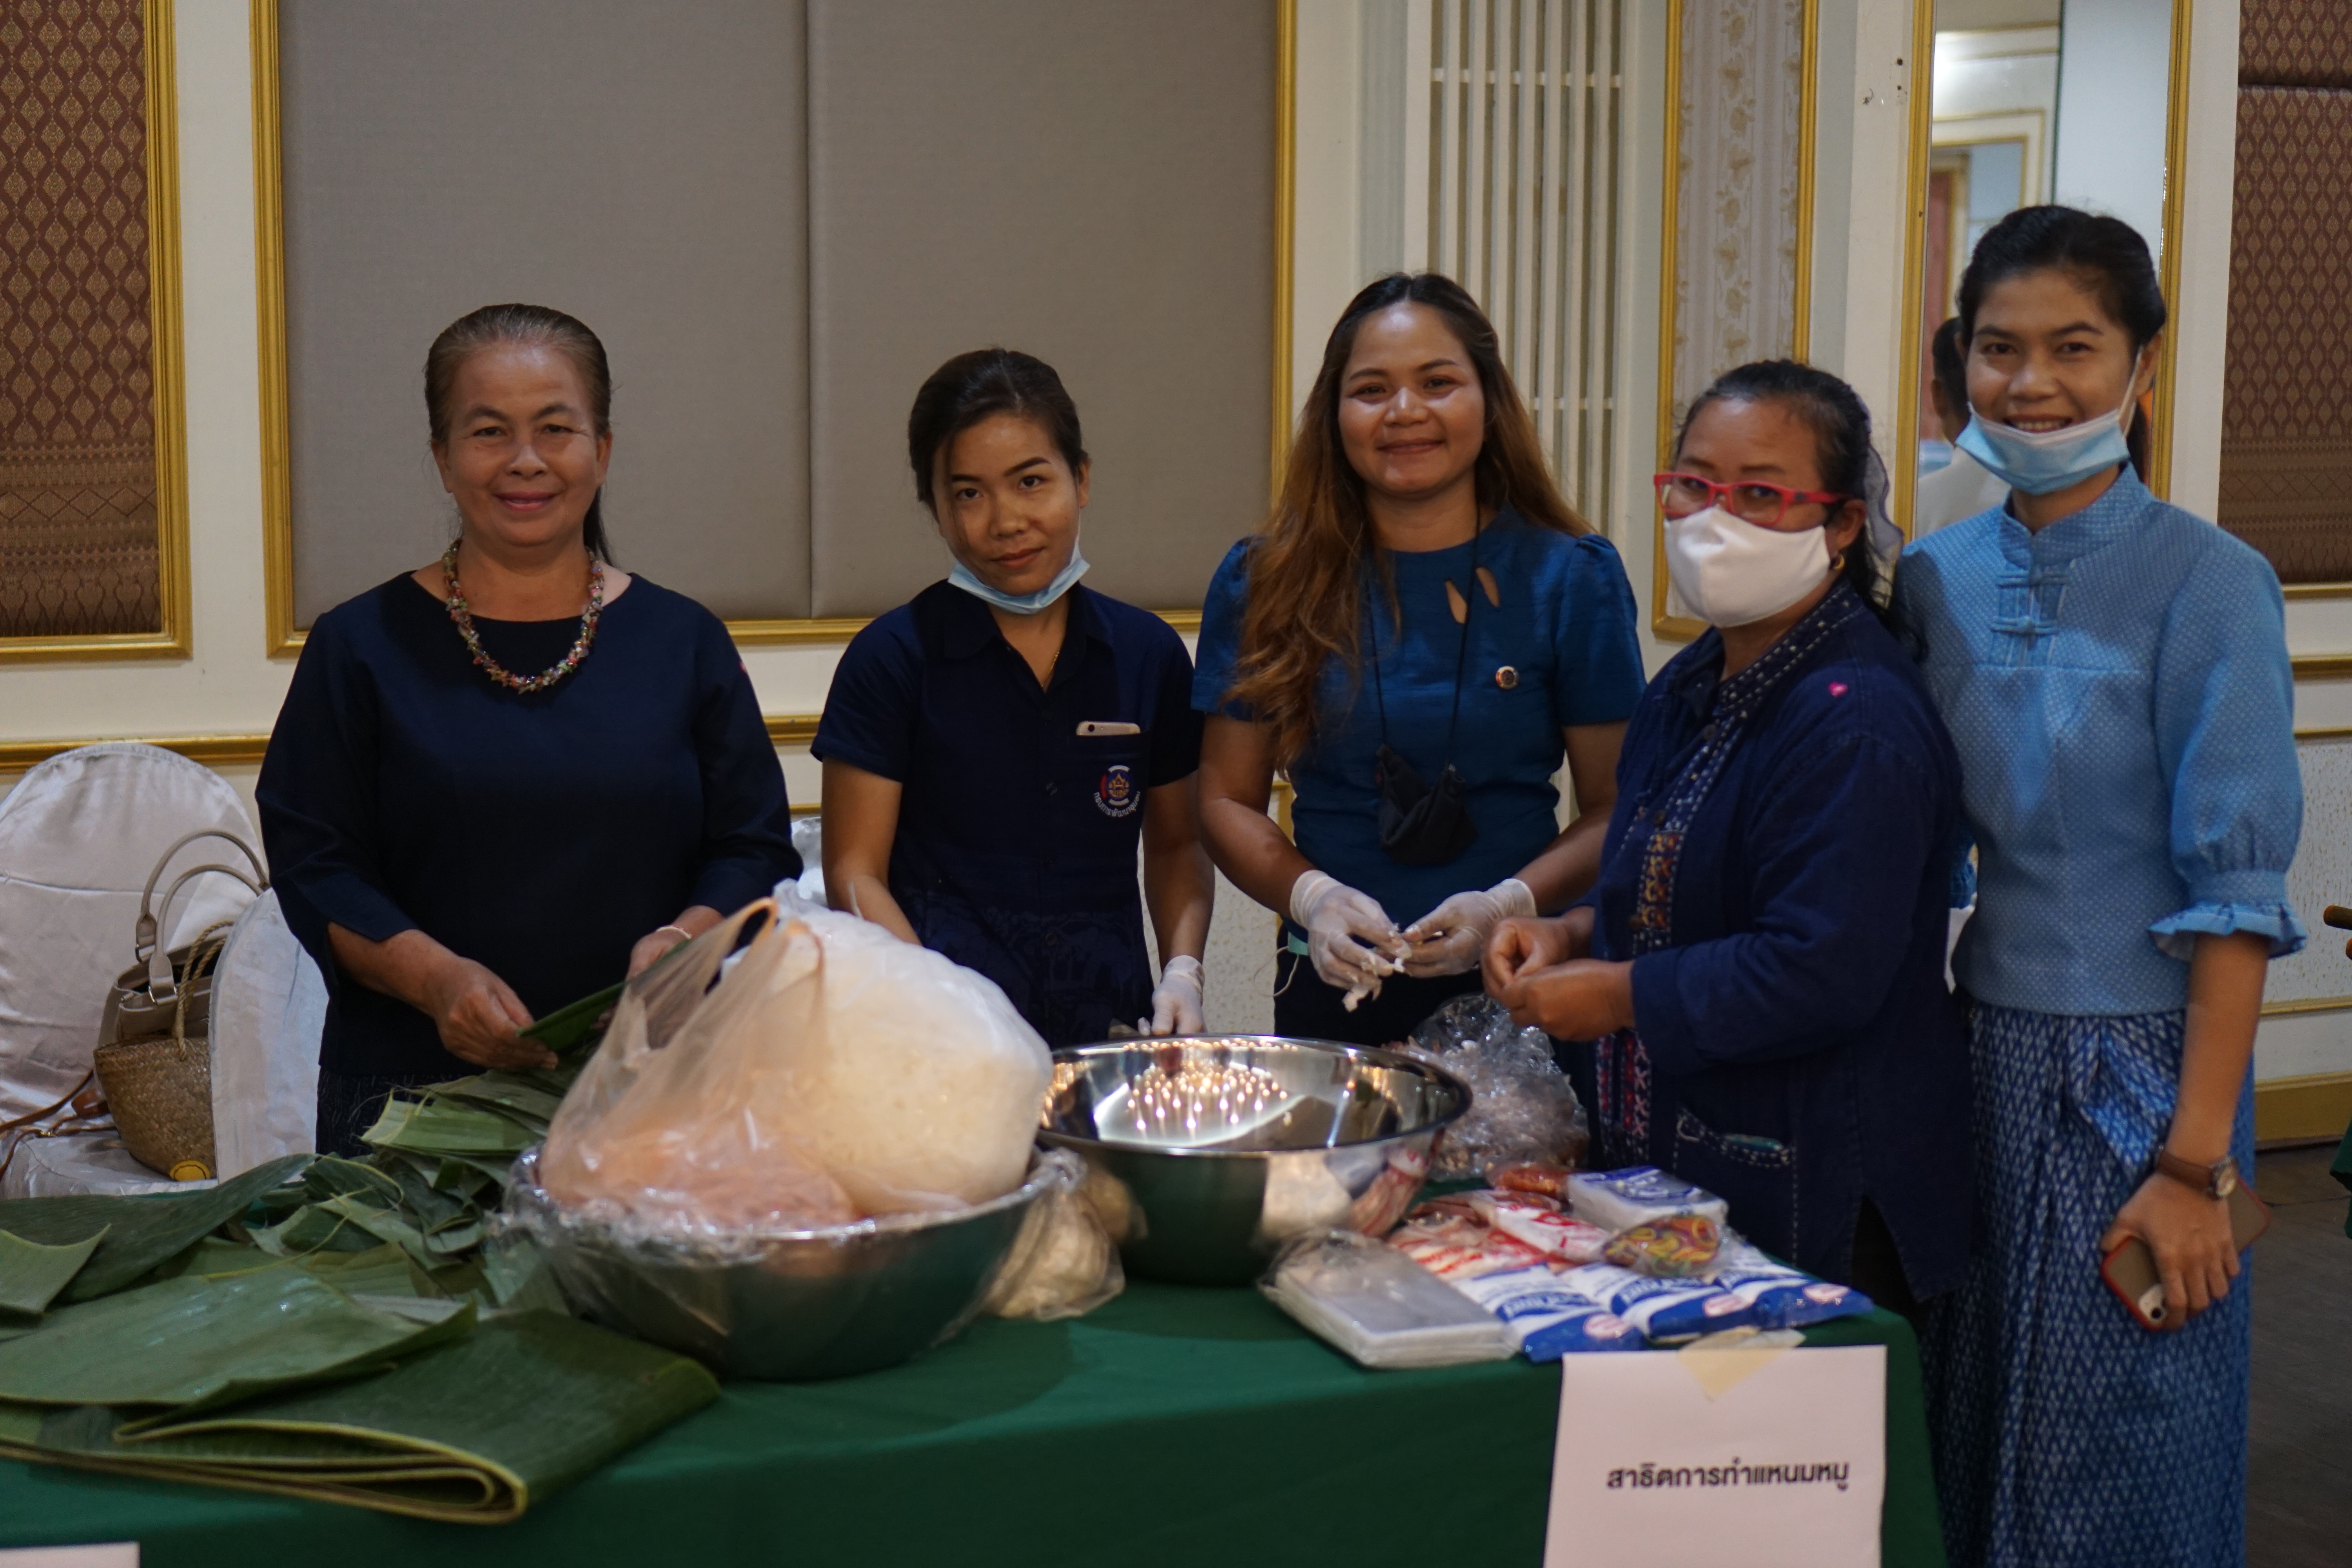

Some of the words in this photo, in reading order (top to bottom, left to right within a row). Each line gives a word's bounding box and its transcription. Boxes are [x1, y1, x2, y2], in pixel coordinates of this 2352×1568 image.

[1607, 1457, 1849, 1491] สาธิตการทำแหนมหมู
